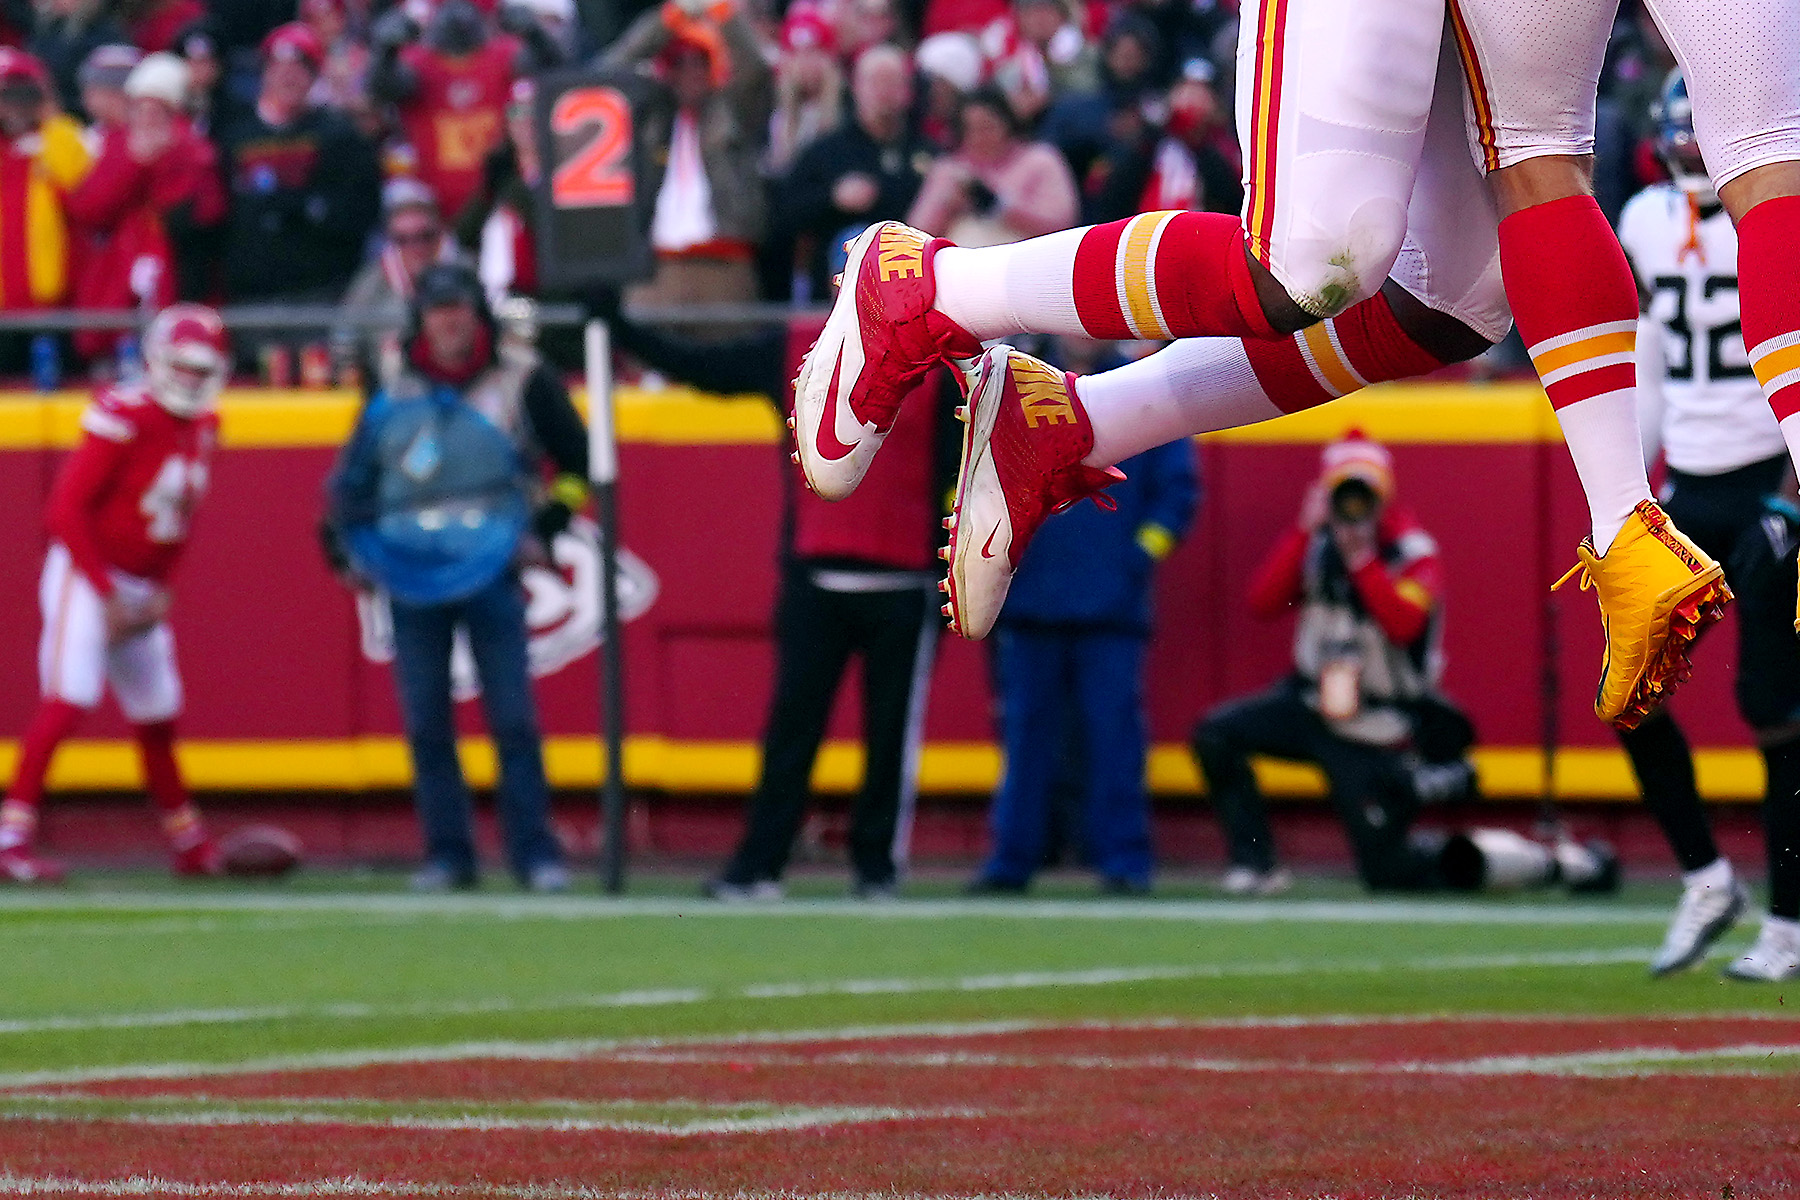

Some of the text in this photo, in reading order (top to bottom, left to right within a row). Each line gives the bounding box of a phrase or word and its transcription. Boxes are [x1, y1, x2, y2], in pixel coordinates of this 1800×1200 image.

[551, 85, 637, 210] 2
[878, 222, 928, 283] NIKE
[1654, 274, 1757, 381] 32
[1008, 350, 1079, 429] NIKE
